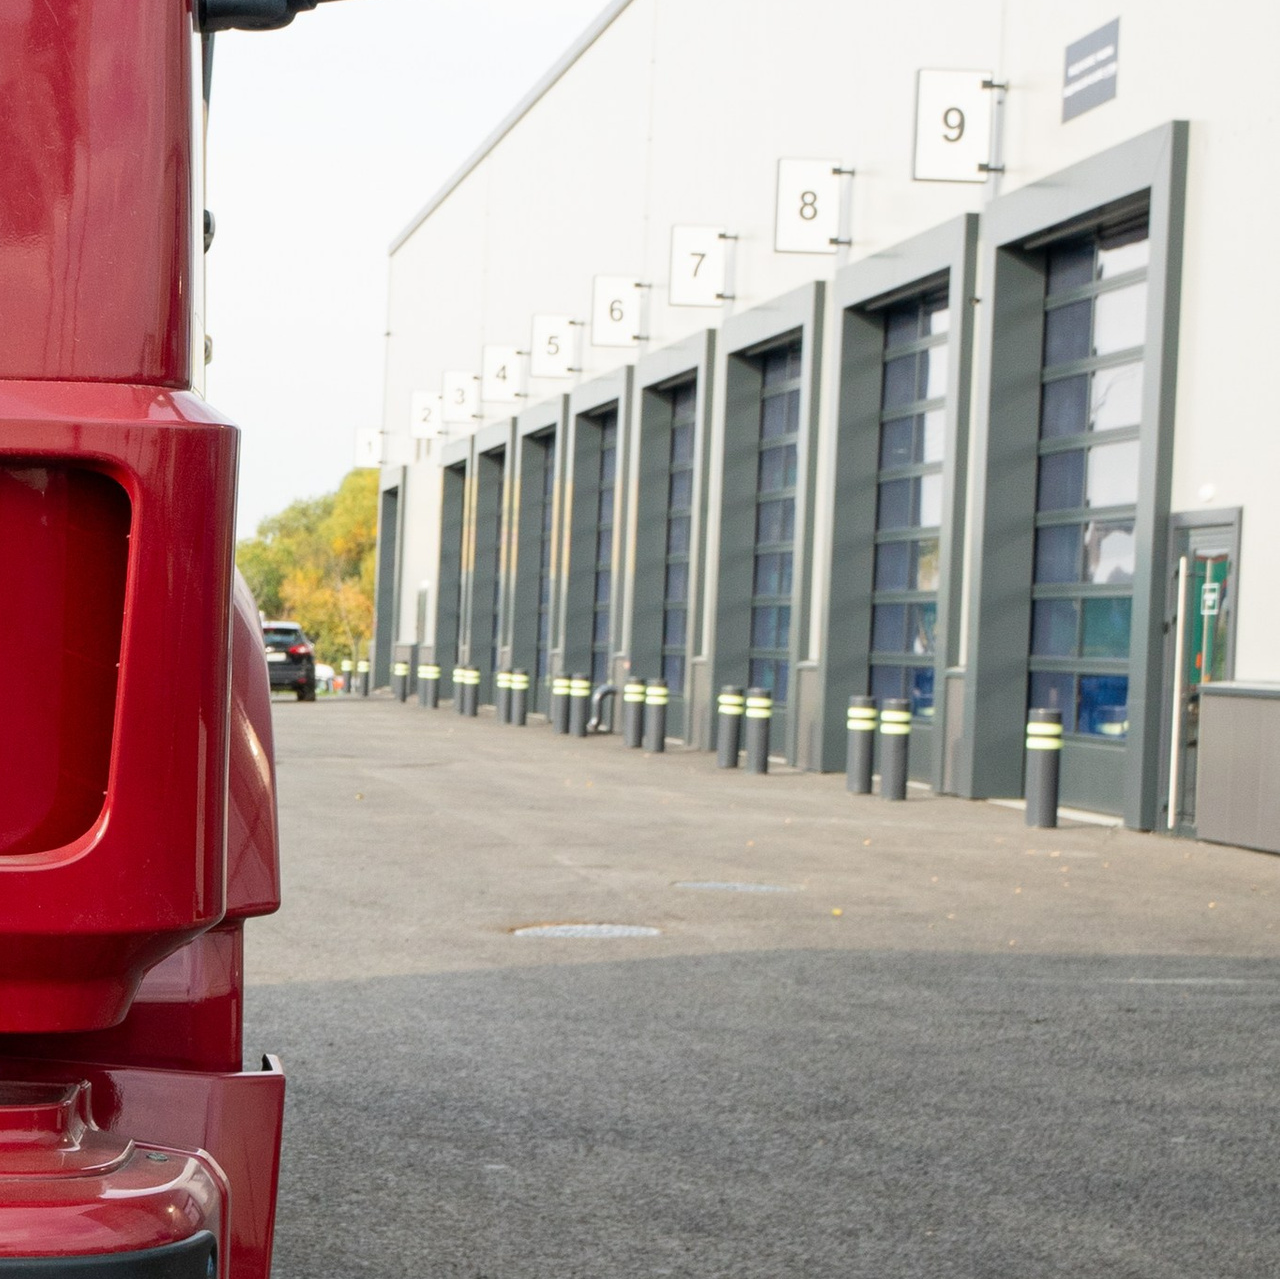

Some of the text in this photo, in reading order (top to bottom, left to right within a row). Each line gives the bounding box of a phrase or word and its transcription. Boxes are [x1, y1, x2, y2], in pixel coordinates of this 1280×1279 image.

[942, 107, 966, 143] 9
[799, 190, 818, 221] 8
[690, 252, 707, 278] 7
[609, 299, 624, 322] 6
[546, 335, 560, 355] 5
[495, 365, 508, 381] 4
[455, 387, 466, 405] 3
[422, 407, 432, 423] 2
